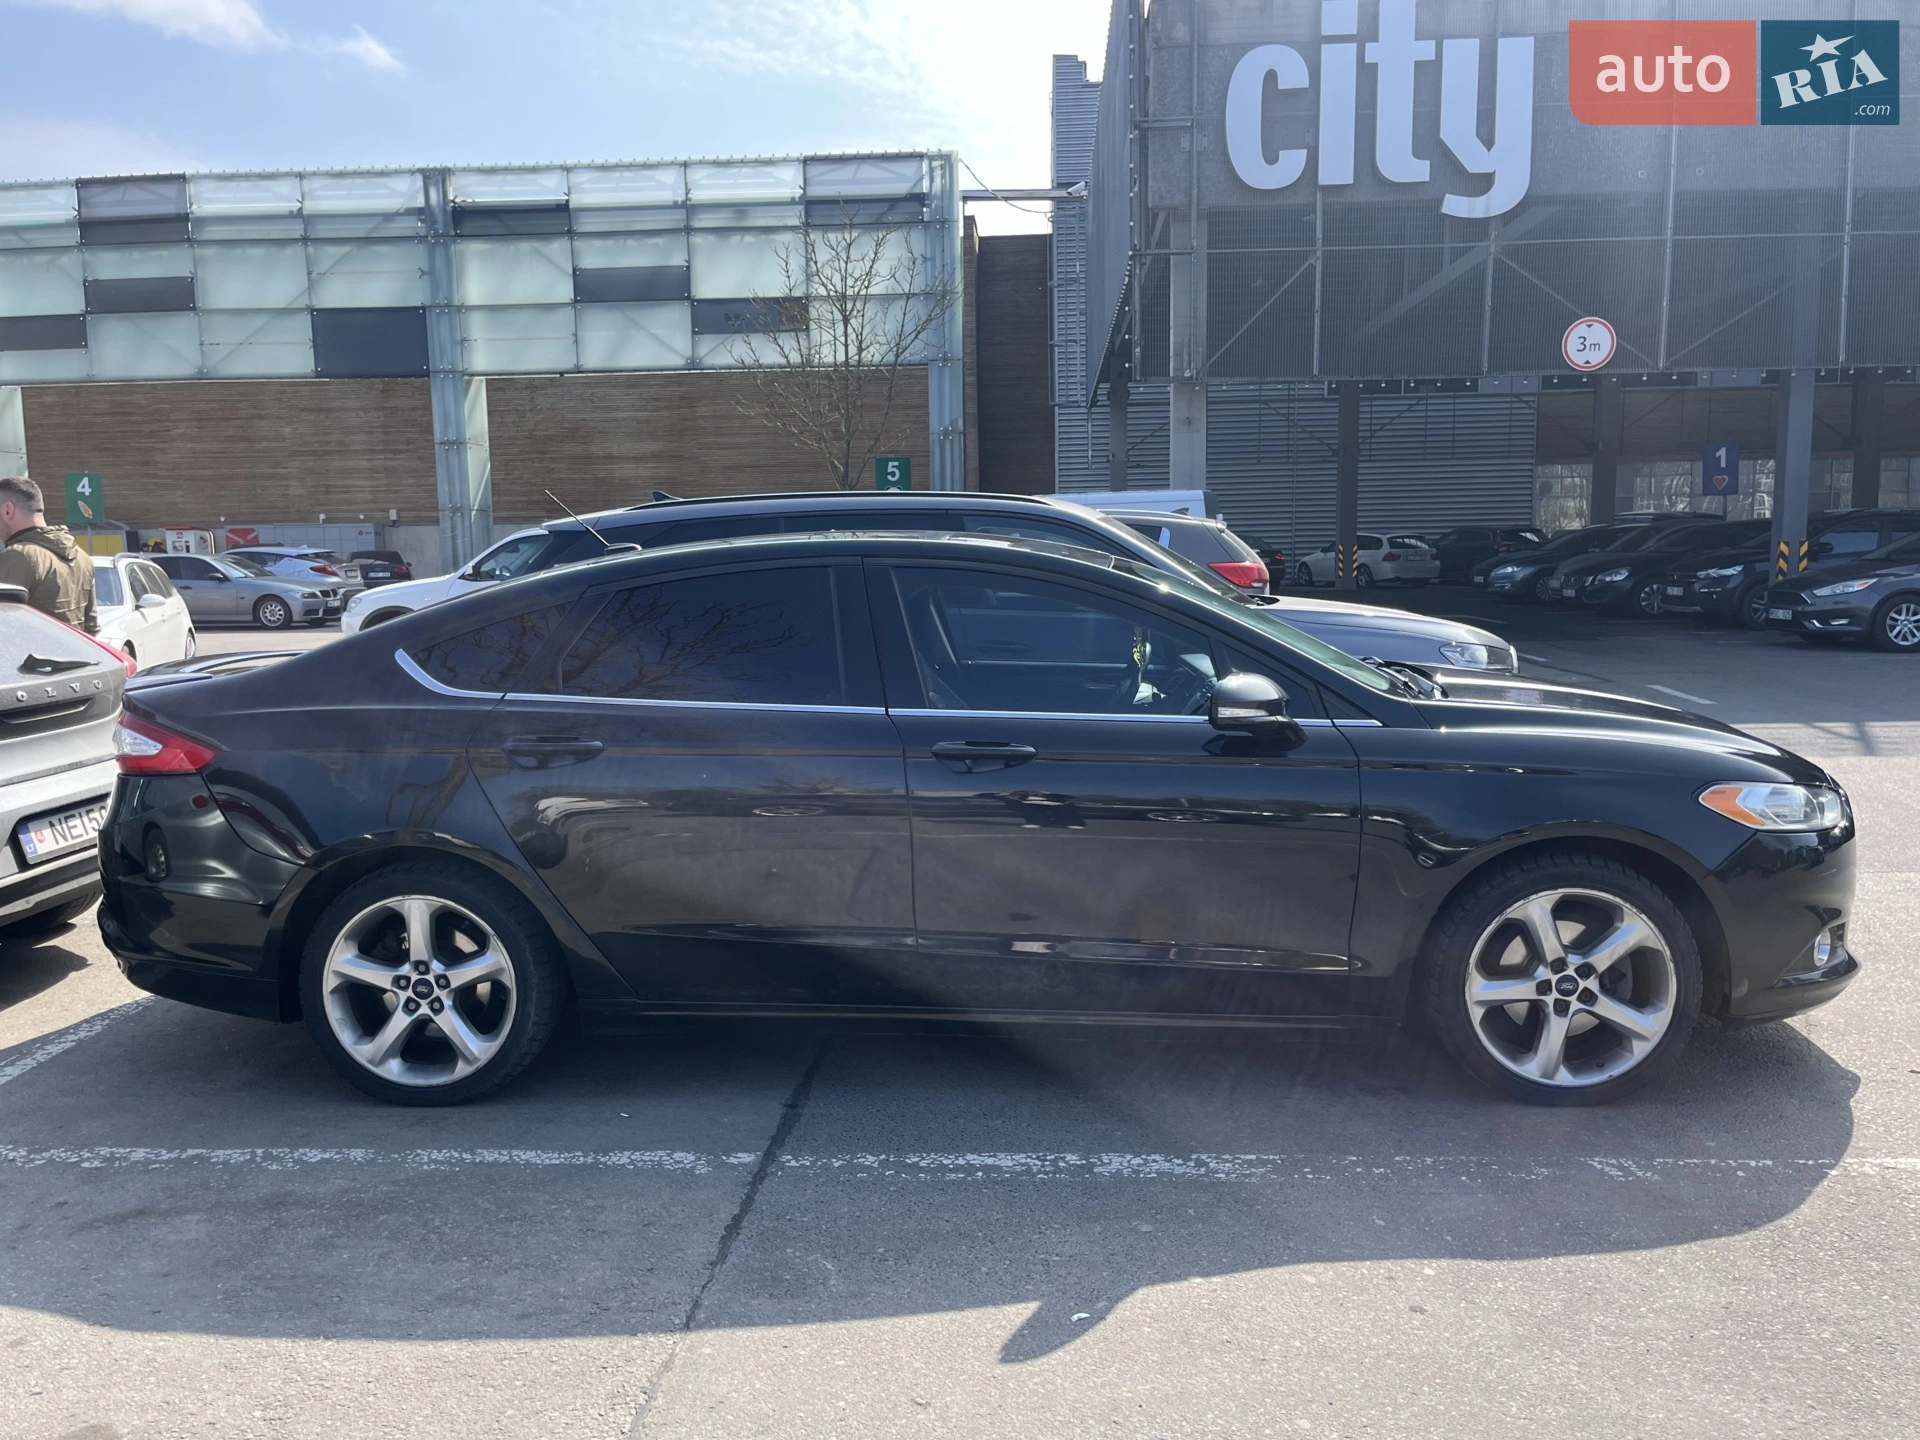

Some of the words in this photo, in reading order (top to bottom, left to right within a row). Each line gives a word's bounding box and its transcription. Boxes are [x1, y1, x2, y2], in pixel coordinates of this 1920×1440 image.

[1225, 0, 1535, 219] city
[1715, 446, 1727, 468] 1
[887, 461, 900, 482] 5
[77, 476, 92, 496] 4
